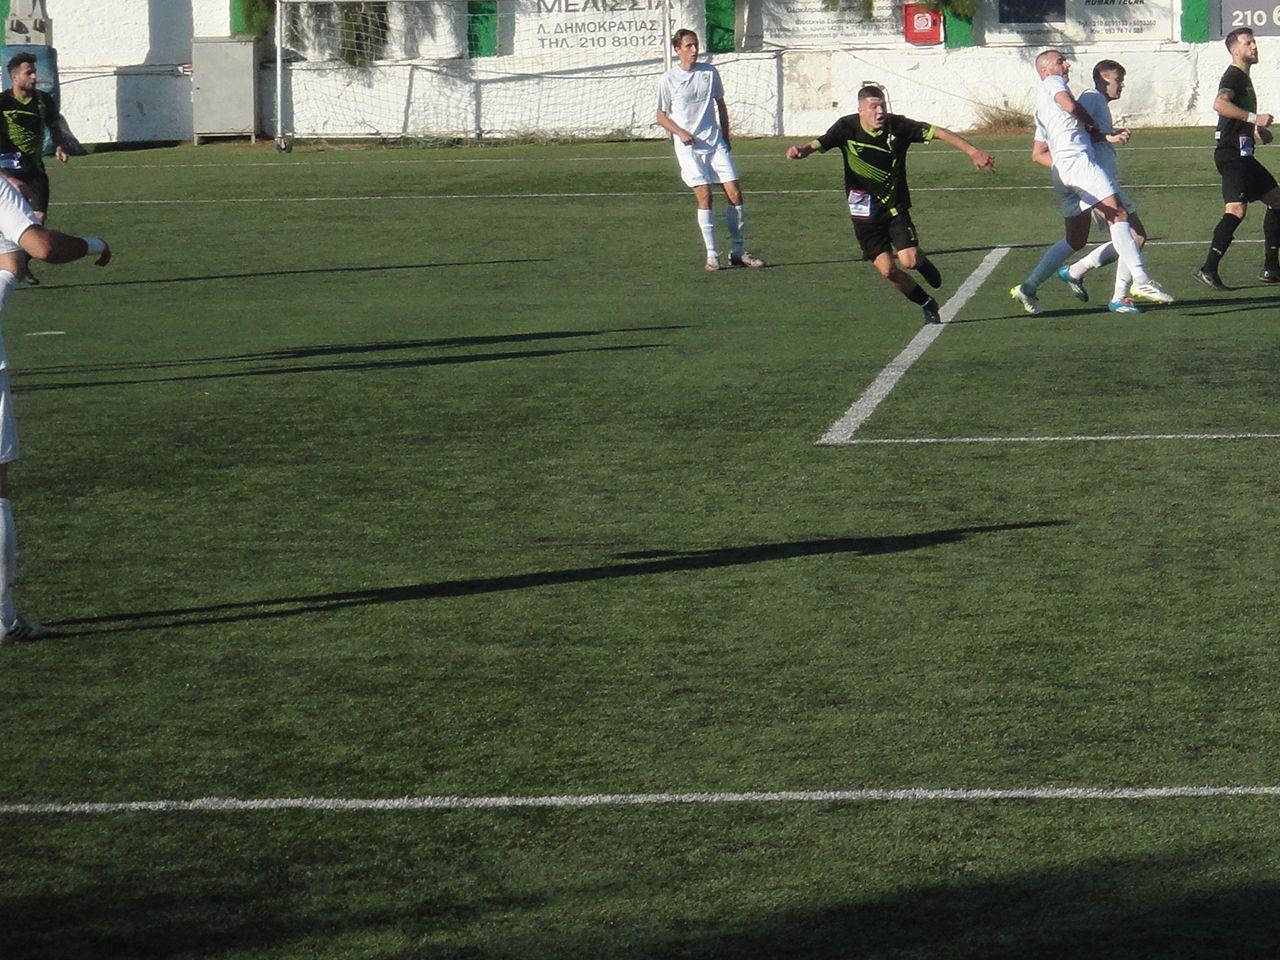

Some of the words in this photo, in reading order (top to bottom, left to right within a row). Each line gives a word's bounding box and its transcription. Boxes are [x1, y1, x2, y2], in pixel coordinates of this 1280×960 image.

[1231, 10, 1268, 27] 210
[554, 19, 657, 34] ΔΗΜΟΚΡΑΤΙΑΣ
[538, 37, 573, 49] ΤΗΛ.
[579, 36, 607, 48] 210
